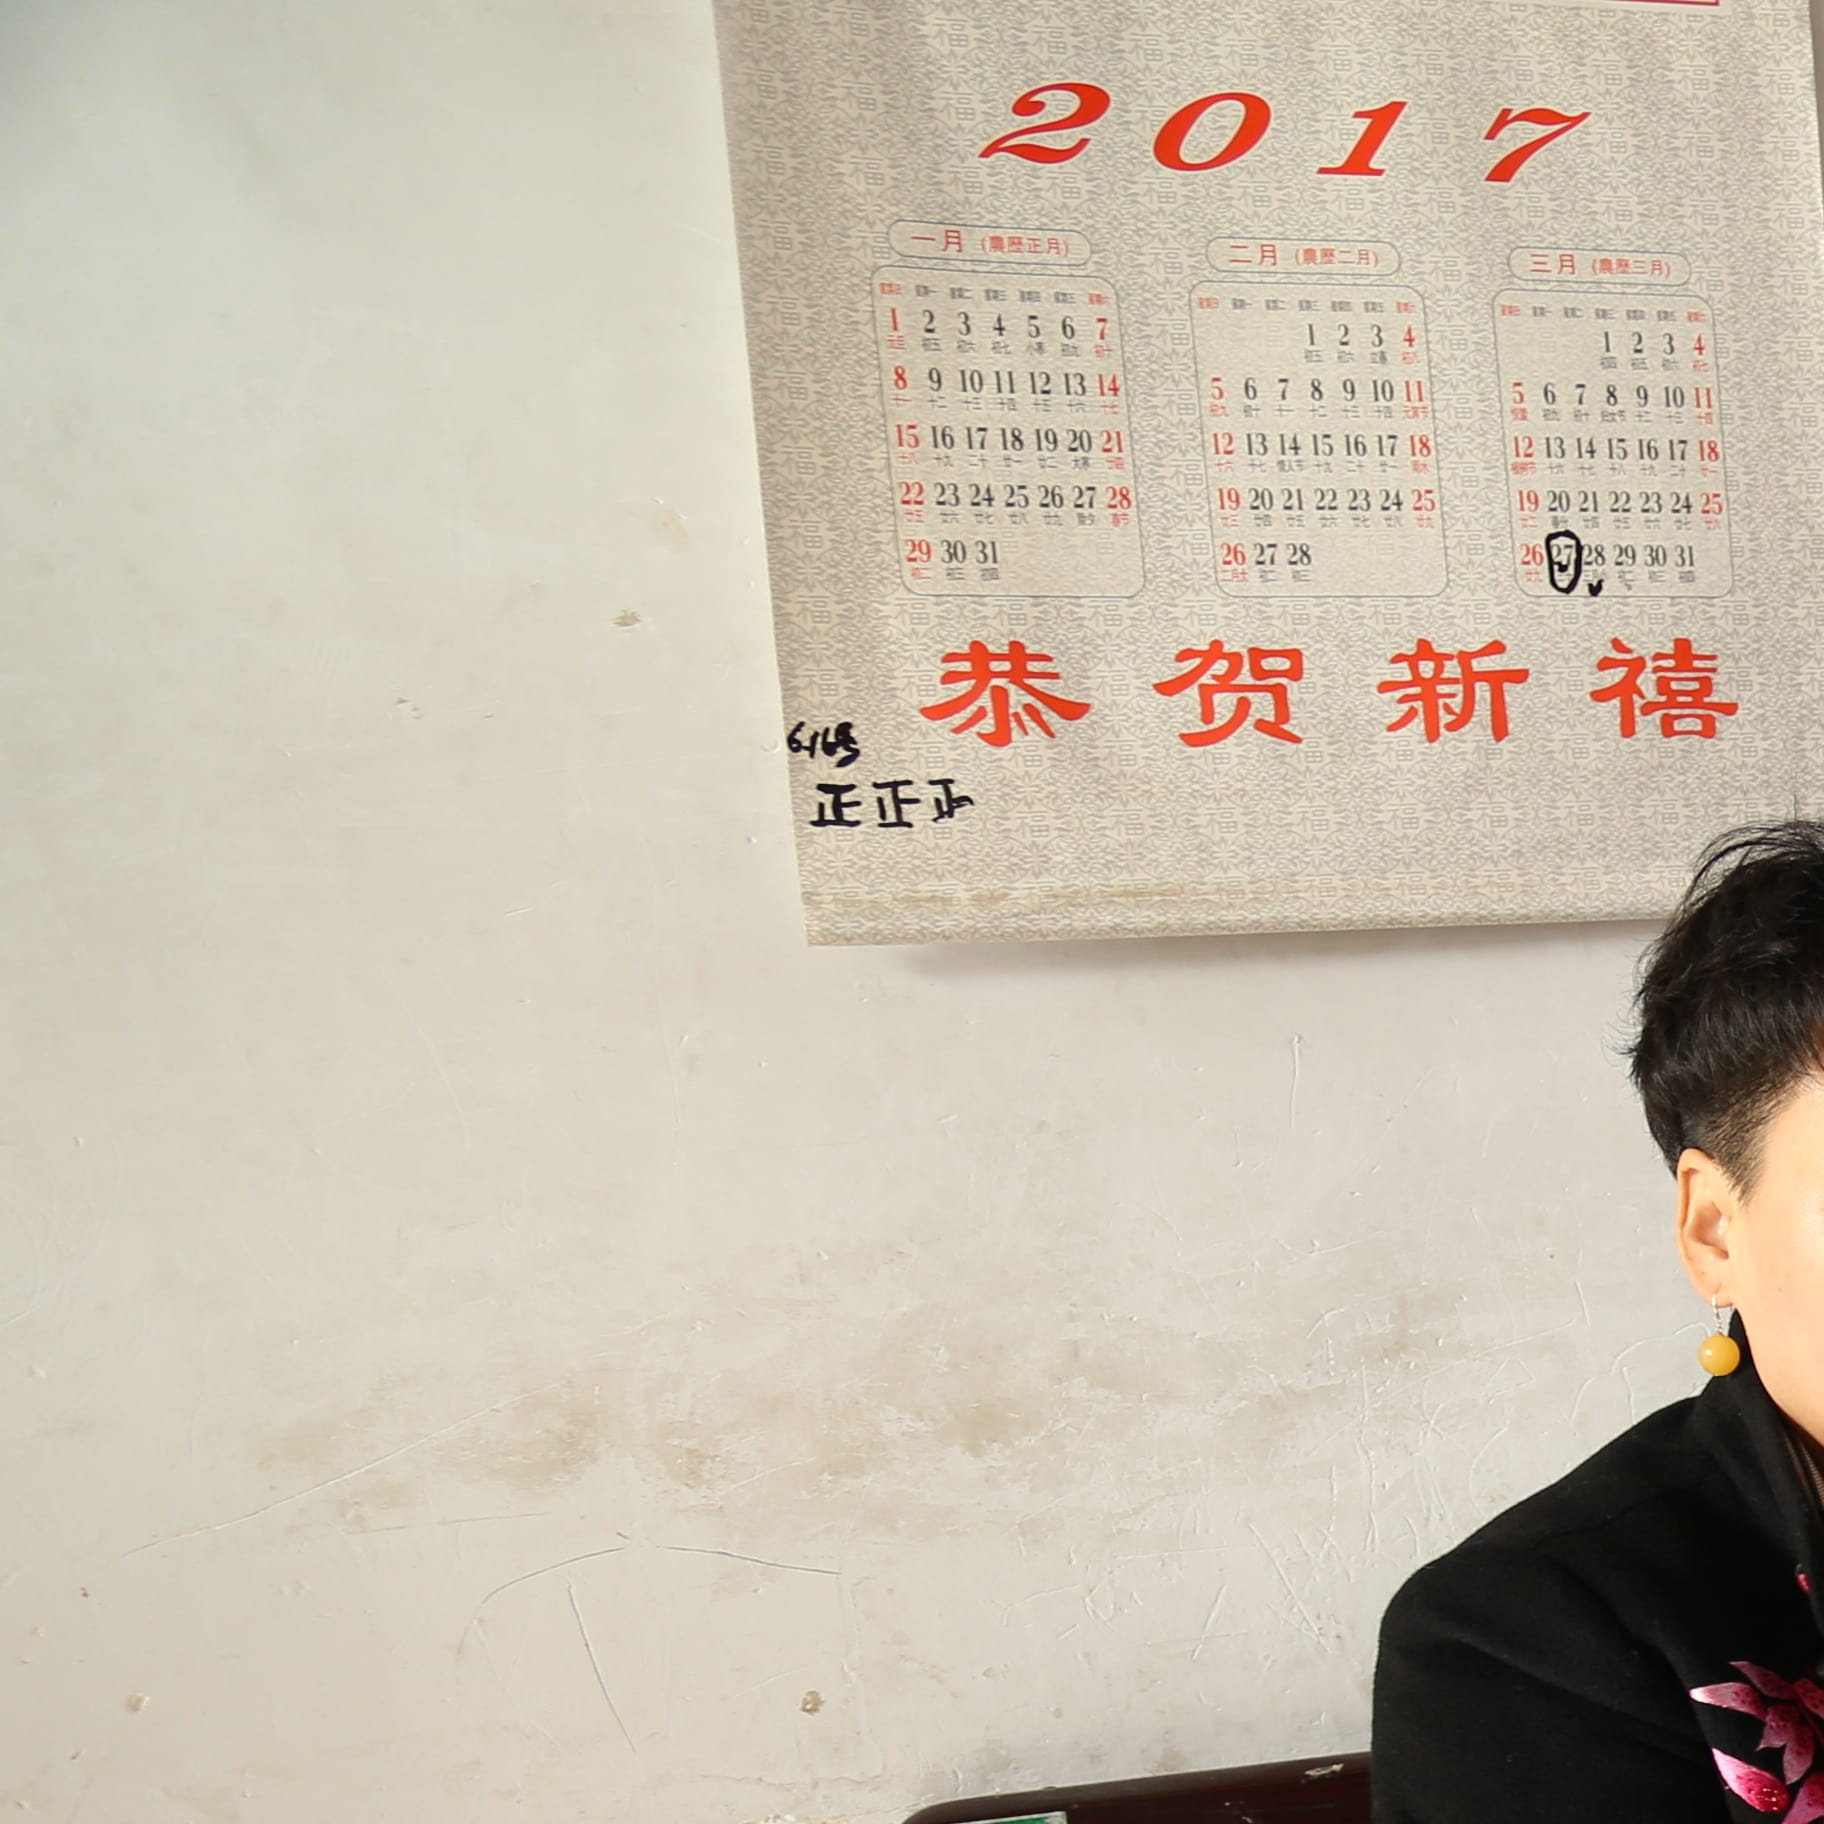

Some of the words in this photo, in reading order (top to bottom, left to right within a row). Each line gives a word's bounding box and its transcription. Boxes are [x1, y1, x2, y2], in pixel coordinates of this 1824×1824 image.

[979, 82, 1591, 183] 2017
[910, 229, 963, 253] 一月
[1229, 244, 1278, 266] 二月
[1530, 254, 1576, 275] 三月
[890, 307, 899, 332] 1
[923, 309, 936, 334] 2
[957, 311, 971, 336] 3
[992, 314, 1006, 337] 4
[1028, 314, 1041, 339] 5
[1061, 315, 1075, 340] 6
[1096, 317, 1108, 341] 7
[1307, 323, 1316, 346] 1
[1339, 323, 1350, 347] 2
[1370, 323, 1384, 348] 3
[1403, 326, 1416, 348] 4
[894, 365, 908, 390] 8
[928, 367, 943, 392] 9
[959, 369, 984, 394] 10
[994, 370, 1016, 395] 11
[1029, 371, 1052, 395] 12
[1063, 372, 1087, 397] 13
[1098, 373, 1120, 397] 14
[1211, 377, 1224, 400] 5
[1243, 377, 1258, 401] 6
[1277, 378, 1289, 401] 7
[1310, 378, 1324, 401] 8
[1342, 378, 1356, 402] 9
[1371, 379, 1395, 403] 10
[1404, 380, 1424, 403] 11
[895, 423, 920, 449] 15
[931, 425, 955, 450] 16
[966, 426, 988, 450] 17
[1000, 427, 1024, 451] 18
[1034, 428, 1059, 452] 19
[1067, 428, 1093, 453] 20
[1101, 430, 1123, 454] 21
[1212, 432, 1234, 456] 12
[1246, 432, 1269, 456] 13
[1279, 433, 1301, 456] 14
[1312, 433, 1334, 457] 15
[1344, 434, 1367, 457] 16
[1377, 434, 1398, 457] 17
[1409, 434, 1432, 458] 18
[1513, 435, 1534, 458] 12
[1544, 436, 1566, 459] 13
[1576, 437, 1597, 459] 14
[1607, 437, 1628, 460] 15
[1638, 438, 1660, 461] 16
[1668, 439, 1688, 461] 17
[1698, 439, 1720, 462] 18
[898, 481, 924, 506] 22
[934, 482, 960, 507] 23
[969, 483, 995, 508] 24
[1004, 484, 1030, 509] 25
[1037, 484, 1064, 509] 26
[1072, 485, 1097, 509] 27
[1106, 486, 1132, 510] 28
[1217, 487, 1241, 511] 19
[1248, 487, 1274, 511] 20
[1282, 488, 1304, 511] 21
[1314, 487, 1338, 511] 22
[1348, 488, 1371, 512] 23
[1380, 489, 1403, 512] 24
[1411, 488, 1436, 512] 25
[905, 538, 932, 563] 29
[940, 539, 967, 564] 30
[974, 540, 999, 565] 31
[1220, 542, 1246, 566] 26
[1253, 542, 1278, 566] 27
[1286, 543, 1312, 566] 28
[919, 637, 1740, 748] 恭贺新禧
